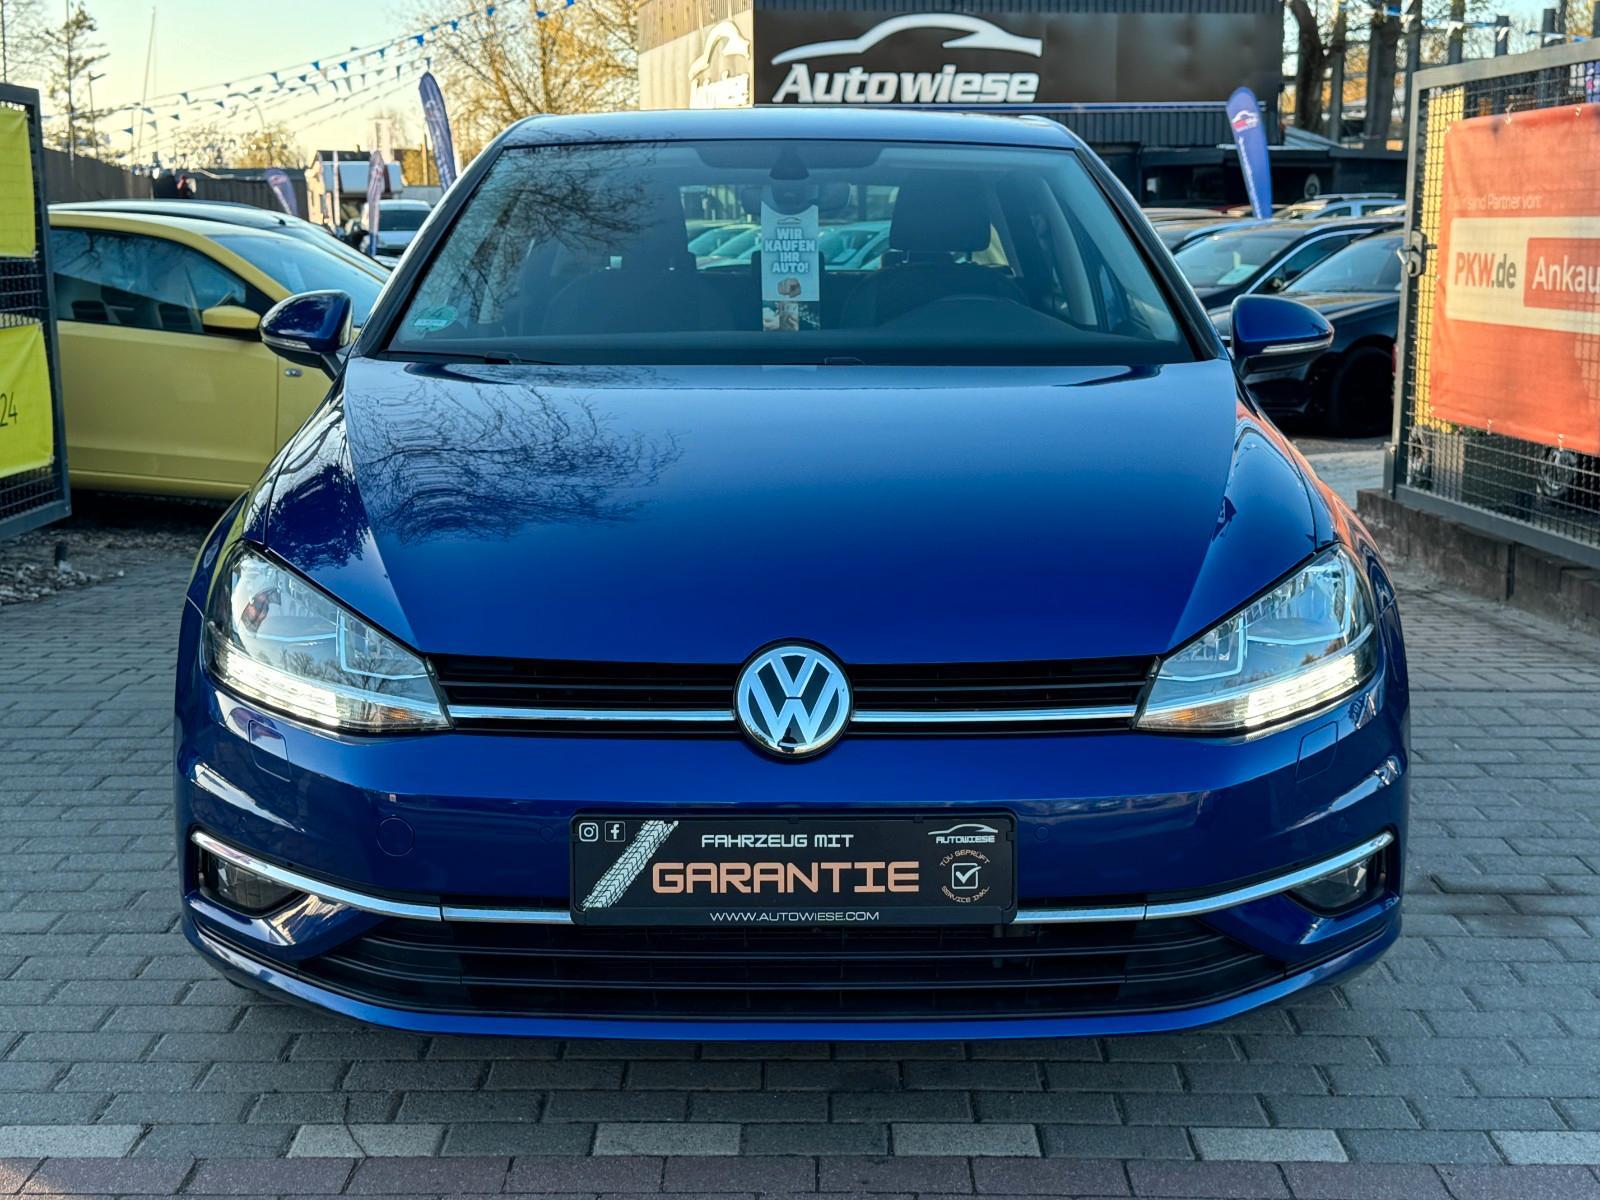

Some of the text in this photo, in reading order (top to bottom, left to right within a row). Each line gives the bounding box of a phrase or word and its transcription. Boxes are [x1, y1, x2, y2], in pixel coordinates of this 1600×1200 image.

[772, 63, 1041, 103] Autowiese
[776, 228, 802, 240] WIR
[764, 240, 816, 252] KAUFEN
[779, 252, 800, 262] IHR
[772, 262, 809, 273] AUTO!
[1454, 251, 1517, 289] PKW.de
[738, 646, 850, 754] VW
[701, 834, 855, 848] FAHRZEUG MIT
[935, 835, 995, 844] AUTOWIESE
[652, 861, 920, 894] GARANTIE
[709, 911, 880, 922] WWW.AUTOWIESE.COM
